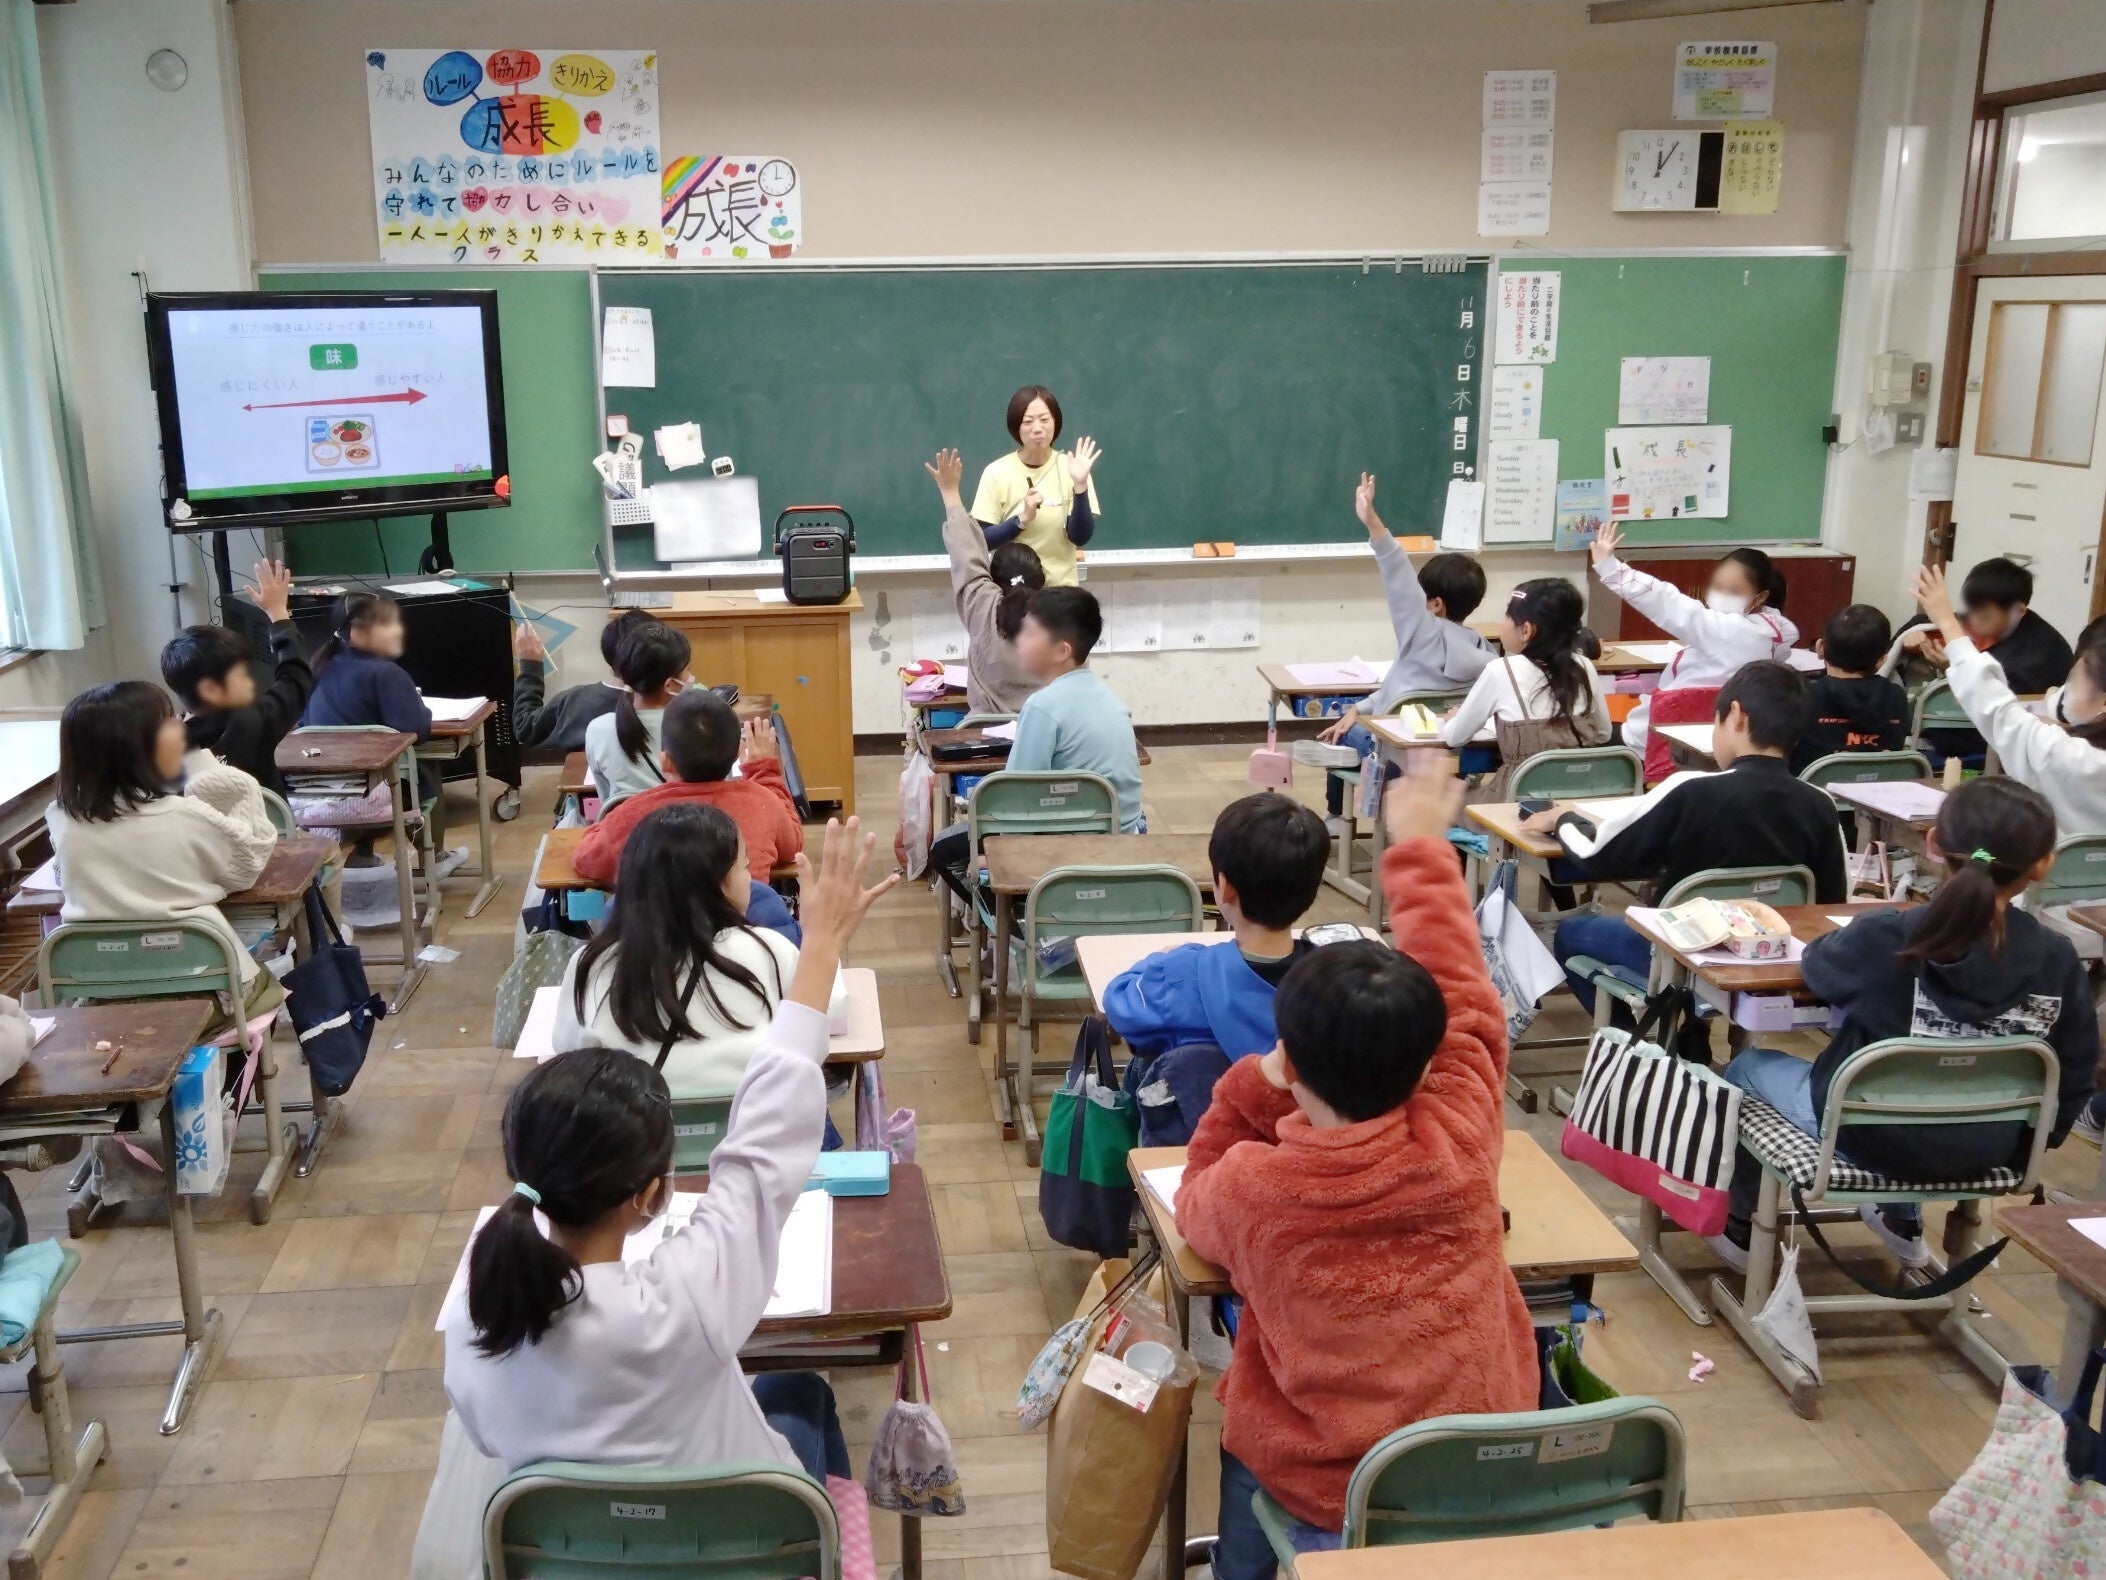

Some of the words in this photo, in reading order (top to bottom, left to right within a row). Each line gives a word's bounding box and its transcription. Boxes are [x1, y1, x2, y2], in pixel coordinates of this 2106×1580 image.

[491, 56, 531, 79] 協力
[555, 63, 609, 92] きりかえ
[428, 72, 472, 96] ルール
[480, 97, 563, 147] 成長
[384, 149, 659, 185] みんなのためにルールを
[384, 191, 595, 217] 守れて協力し合い
[674, 179, 769, 244] 成長
[387, 225, 649, 246] 一人一人がきりかえできる
[453, 246, 539, 263] クラス
[1503, 277, 1513, 309] にしよう
[1514, 276, 1527, 355] 当たり前にできるよう
[1529, 276, 1541, 340] 当たり前のことを
[325, 348, 343, 365] 味
[1496, 465, 1521, 473] Monday
[1497, 454, 1520, 463] Sunday
[1494, 508, 1513, 516] Friday
[1554, 1436, 1564, 1447] L
[616, 1506, 656, 1516] 4-2-17
